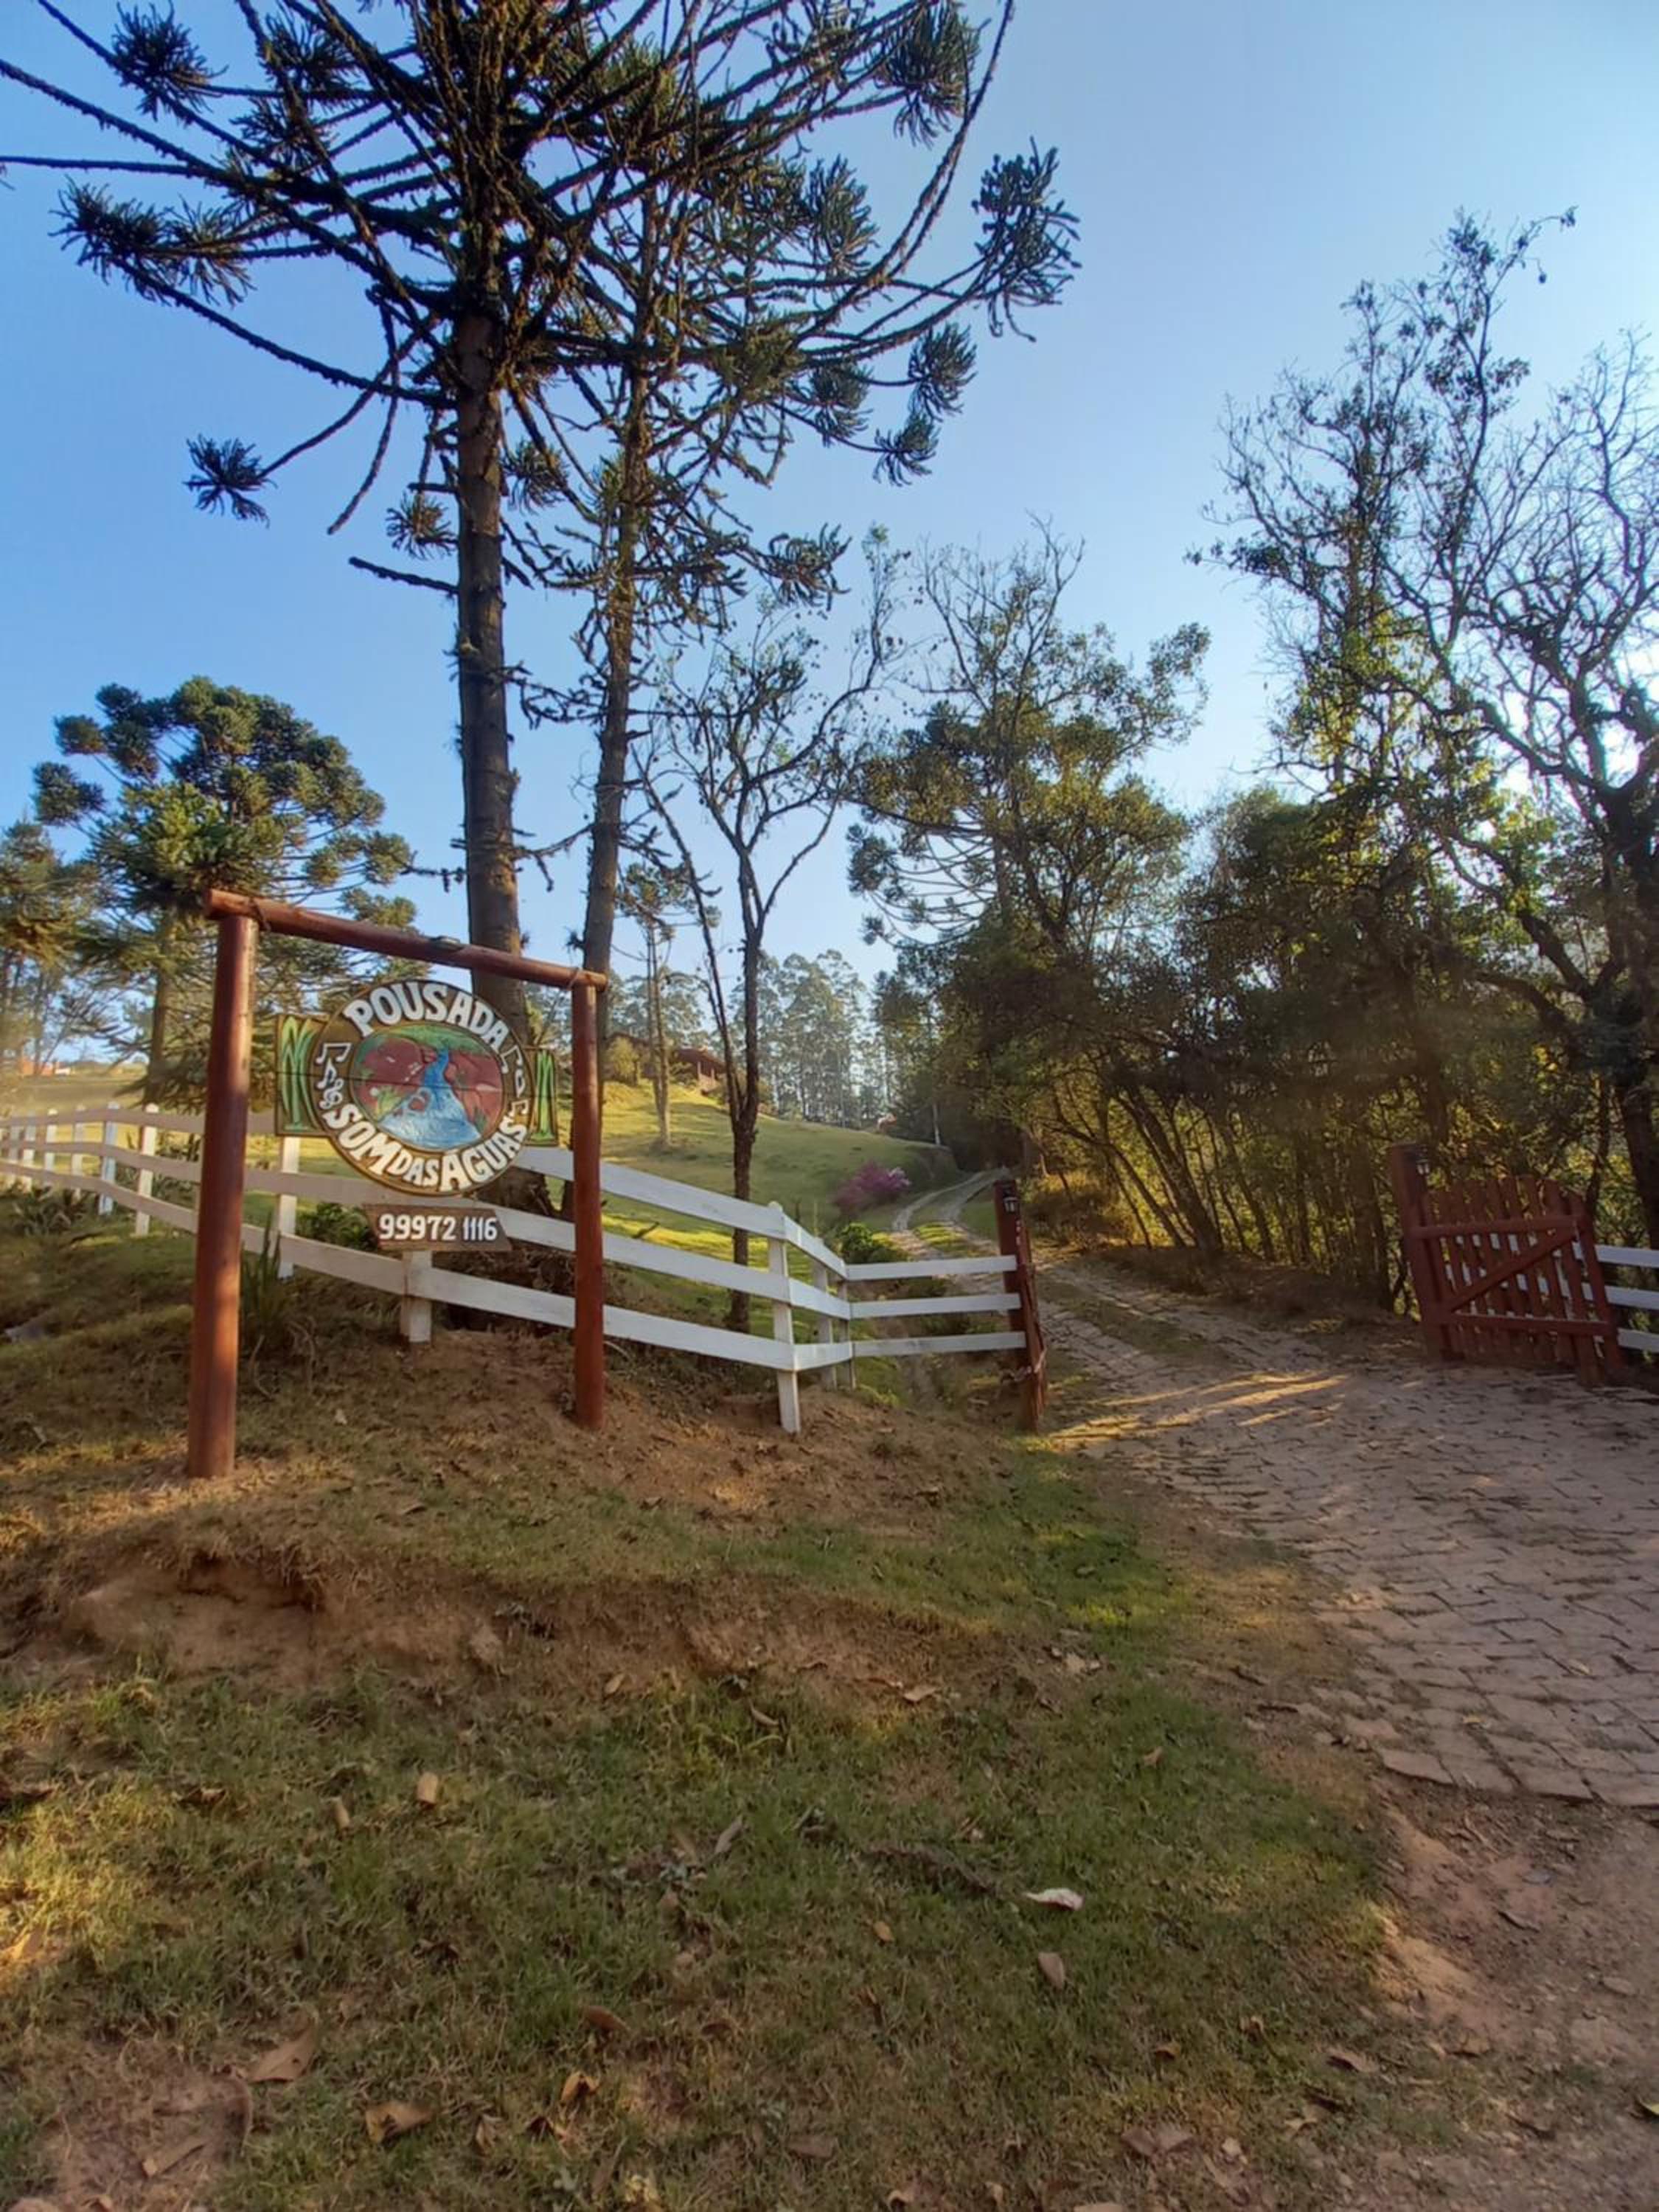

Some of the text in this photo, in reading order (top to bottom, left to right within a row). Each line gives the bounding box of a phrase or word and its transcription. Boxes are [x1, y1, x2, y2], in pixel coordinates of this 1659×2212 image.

[343, 981, 509, 1052] POUSADA
[322, 1104, 402, 1175] SOM
[386, 1149, 440, 1186] DAS
[379, 1214, 498, 1240] 99972 1116
